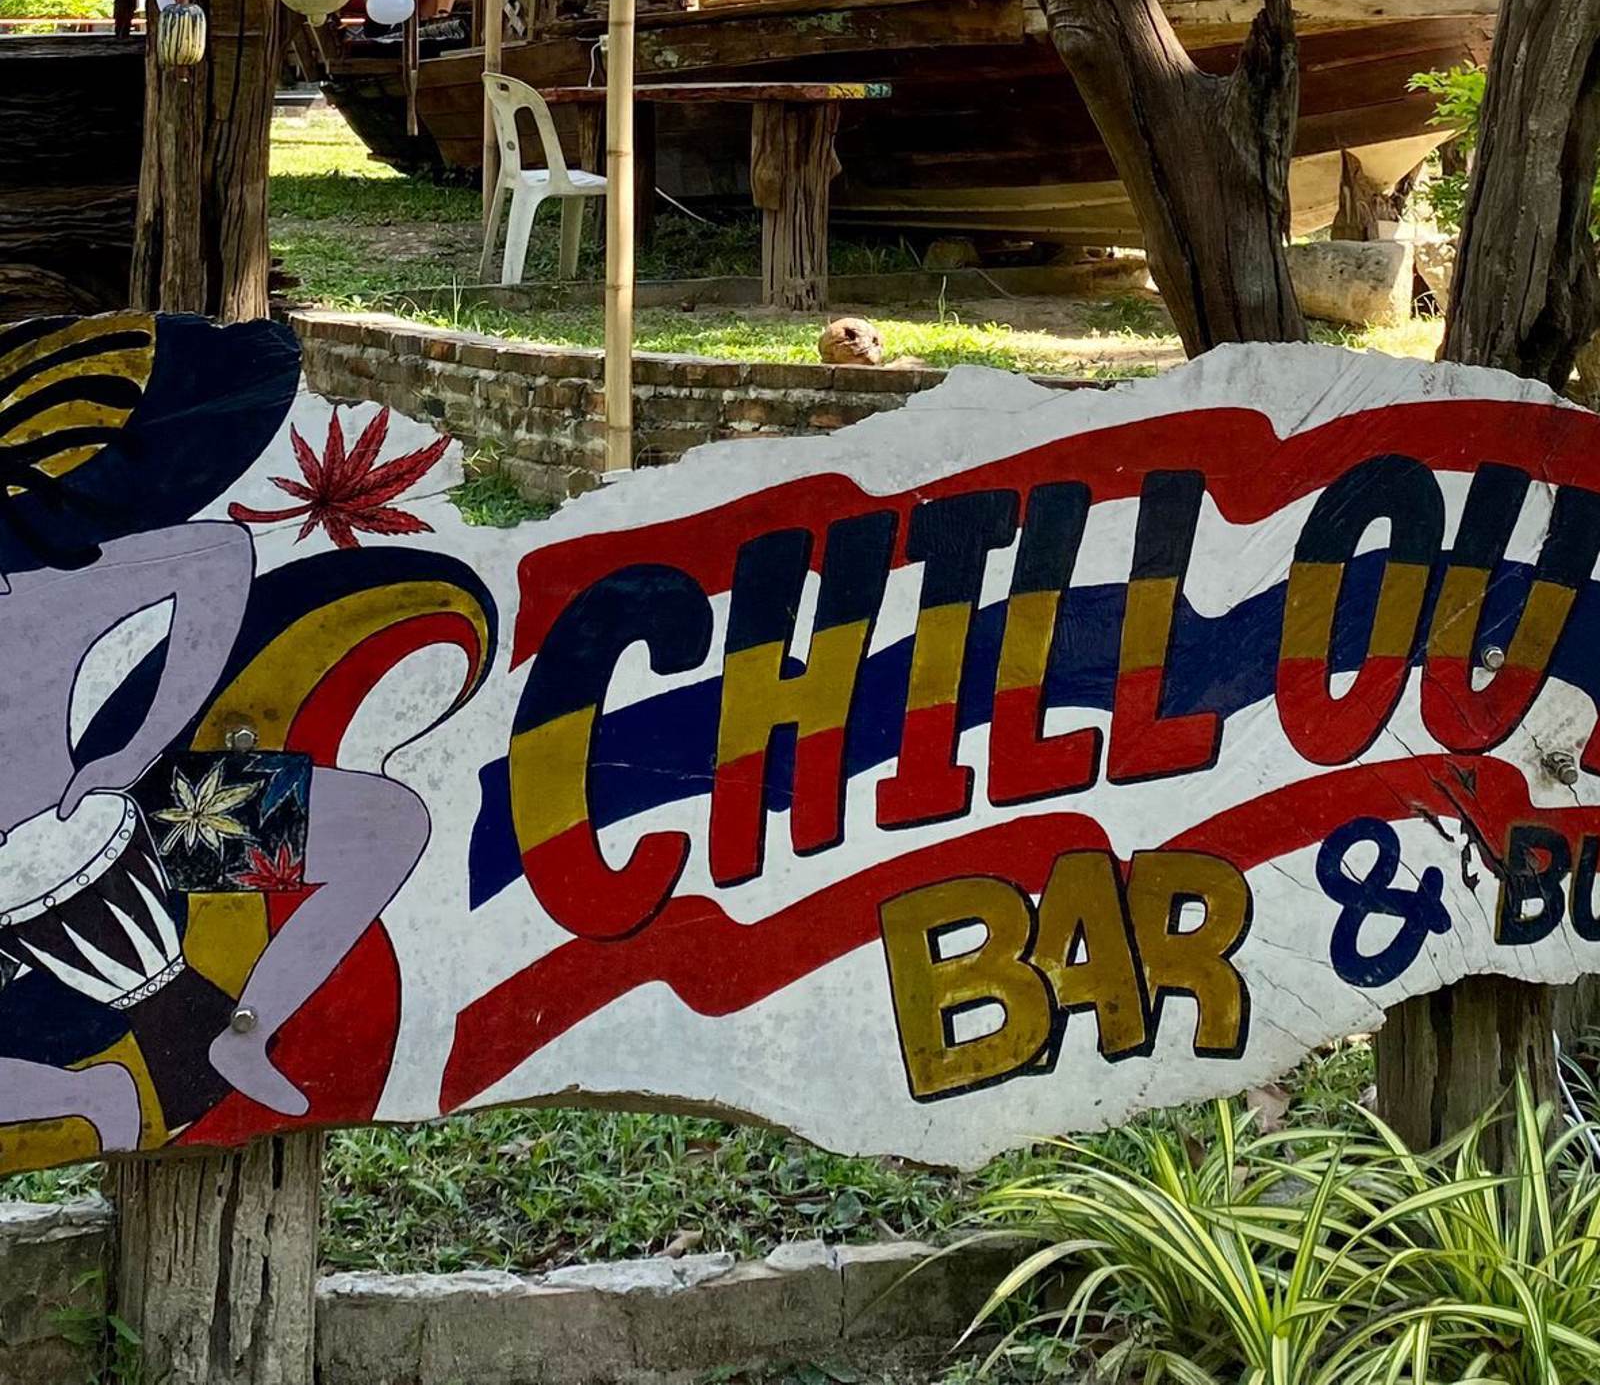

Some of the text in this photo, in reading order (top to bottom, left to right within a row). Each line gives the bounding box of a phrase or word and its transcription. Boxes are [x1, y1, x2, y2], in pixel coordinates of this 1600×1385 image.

[509, 453, 1600, 941] CHILL OU
[880, 850, 1253, 1102] BAR
[1316, 817, 1451, 988] &
